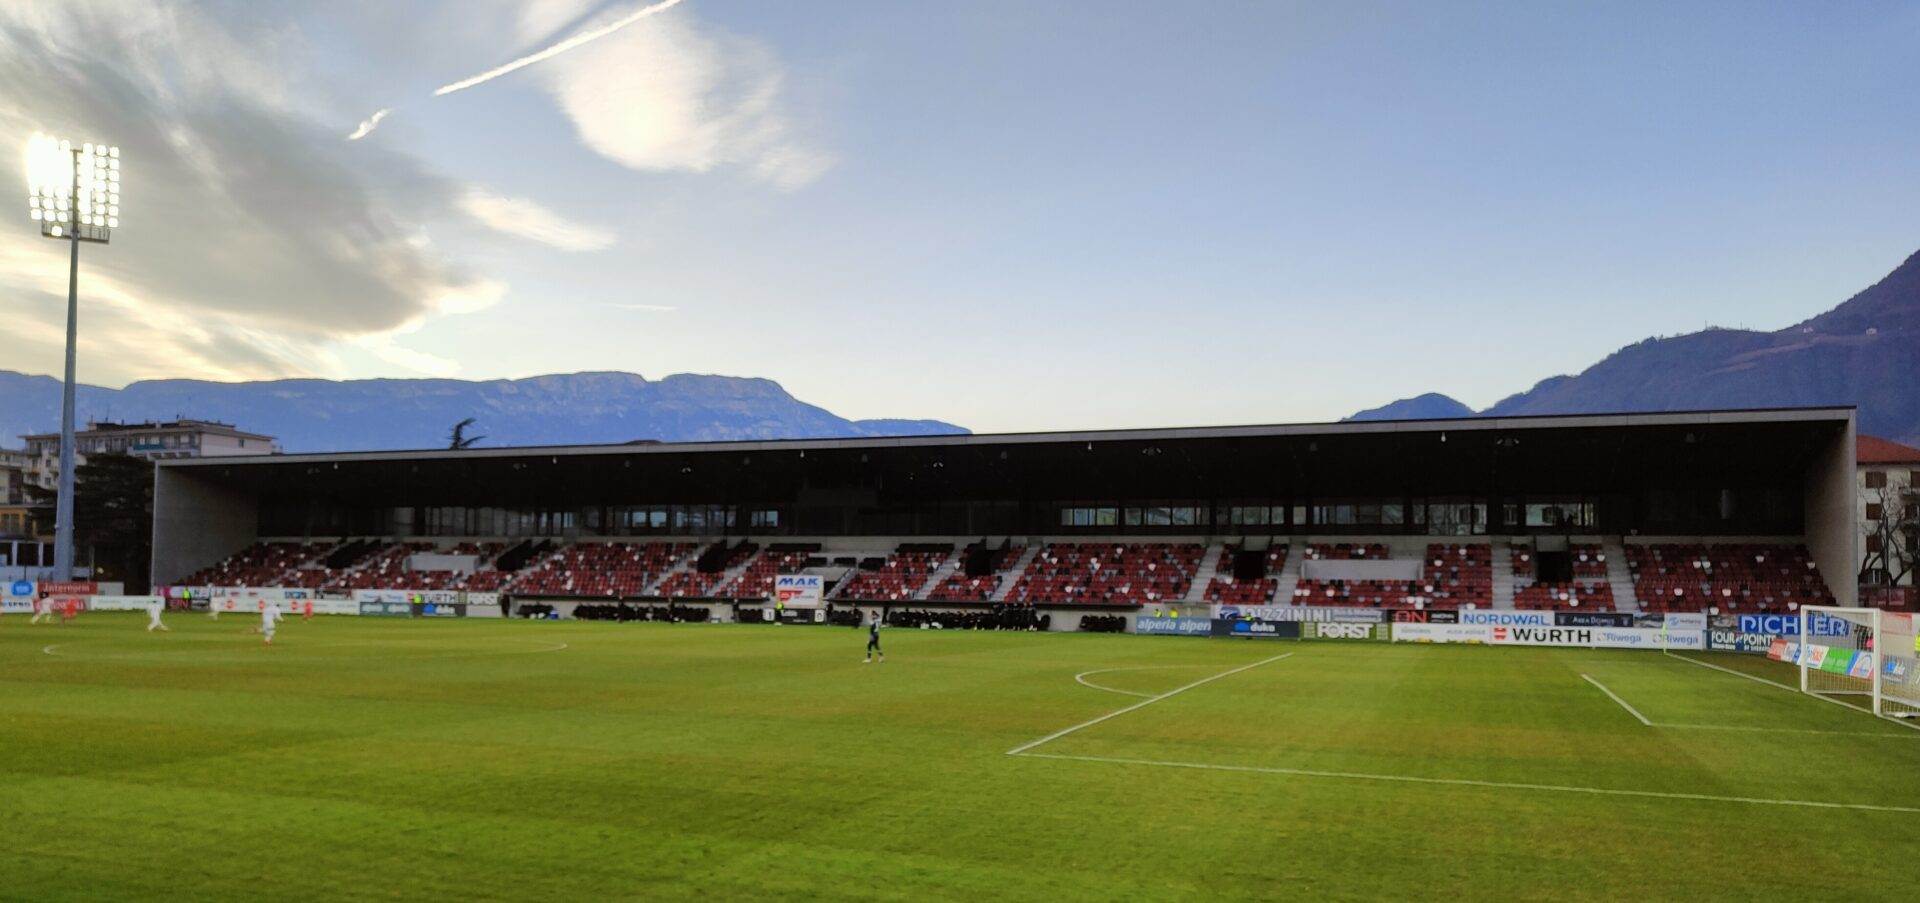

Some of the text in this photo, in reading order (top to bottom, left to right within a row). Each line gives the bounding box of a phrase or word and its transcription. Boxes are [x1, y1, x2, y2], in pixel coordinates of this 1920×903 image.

[778, 577, 818, 586] MAK
[1464, 614, 1551, 626] NORDWAL
[1317, 622, 1373, 639] FORST
[1512, 628, 1591, 643] WÜRTH
[1711, 631, 1735, 645] FOUR
